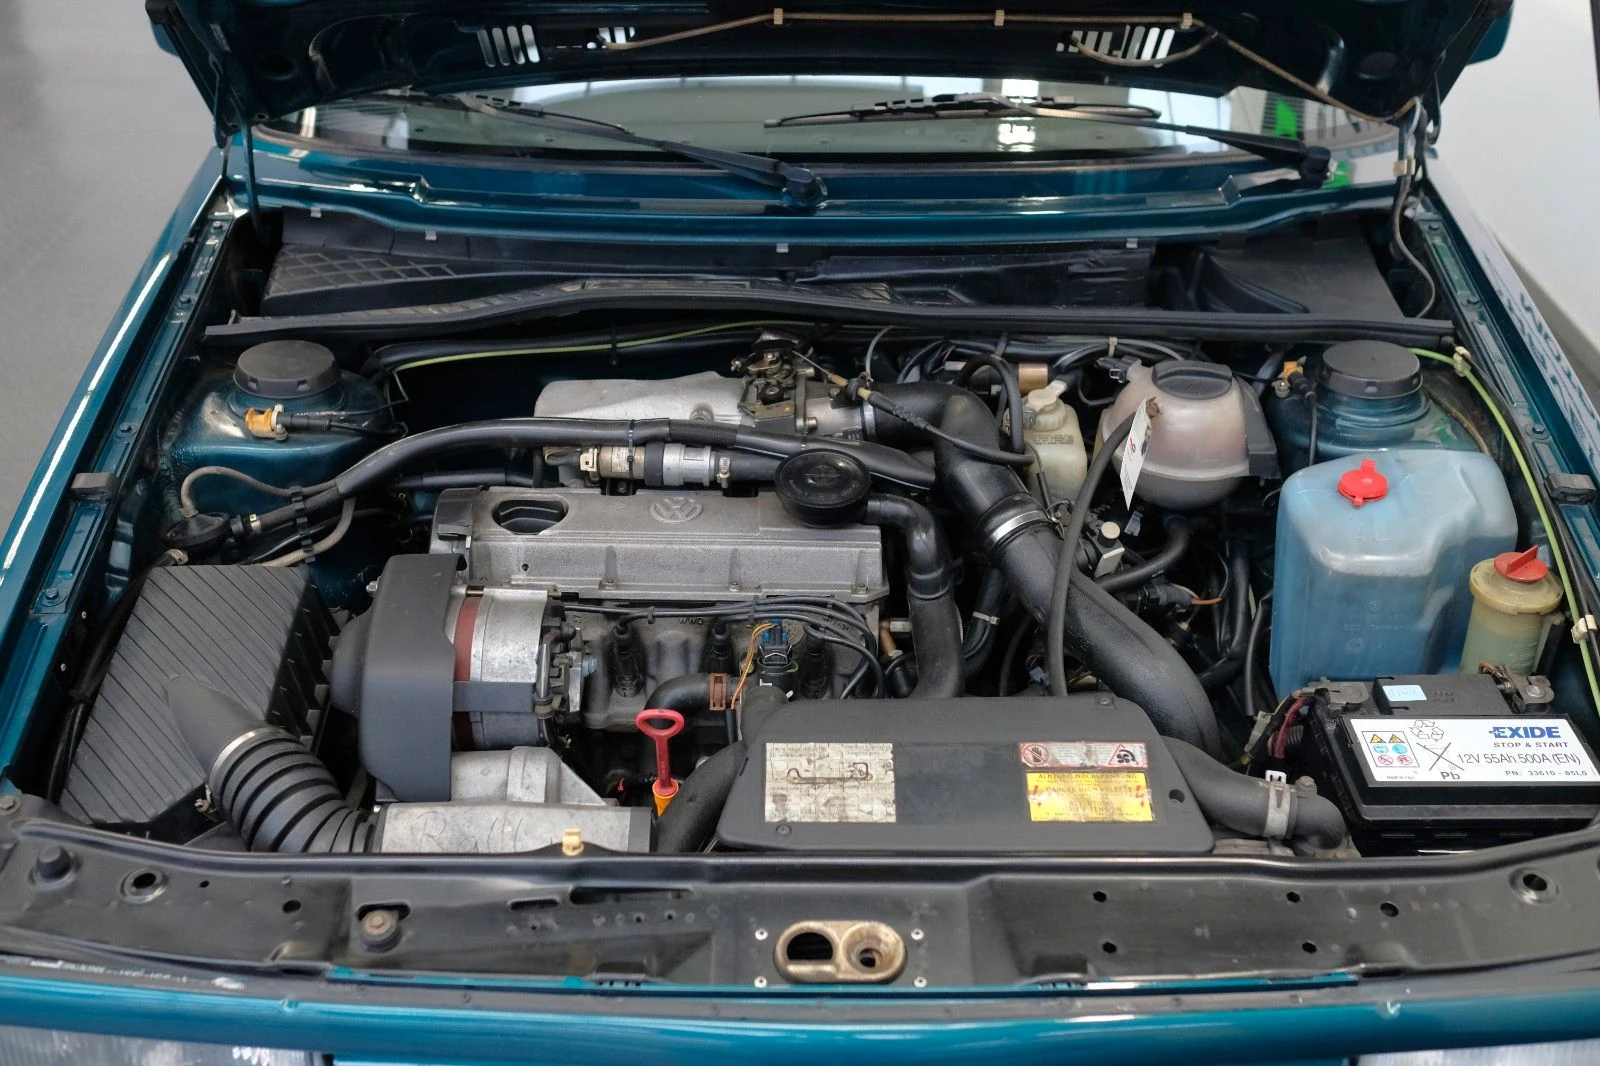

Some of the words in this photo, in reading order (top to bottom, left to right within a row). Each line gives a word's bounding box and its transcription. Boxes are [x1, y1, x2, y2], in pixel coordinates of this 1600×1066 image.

[1489, 727, 1561, 738] EXIDE
[1457, 753, 1480, 763] 12V
[1483, 753, 1517, 764] 55Ah
[1518, 753, 1552, 764] 500A
[1551, 753, 1581, 766] (EN)
[1440, 771, 1461, 780] Pb
